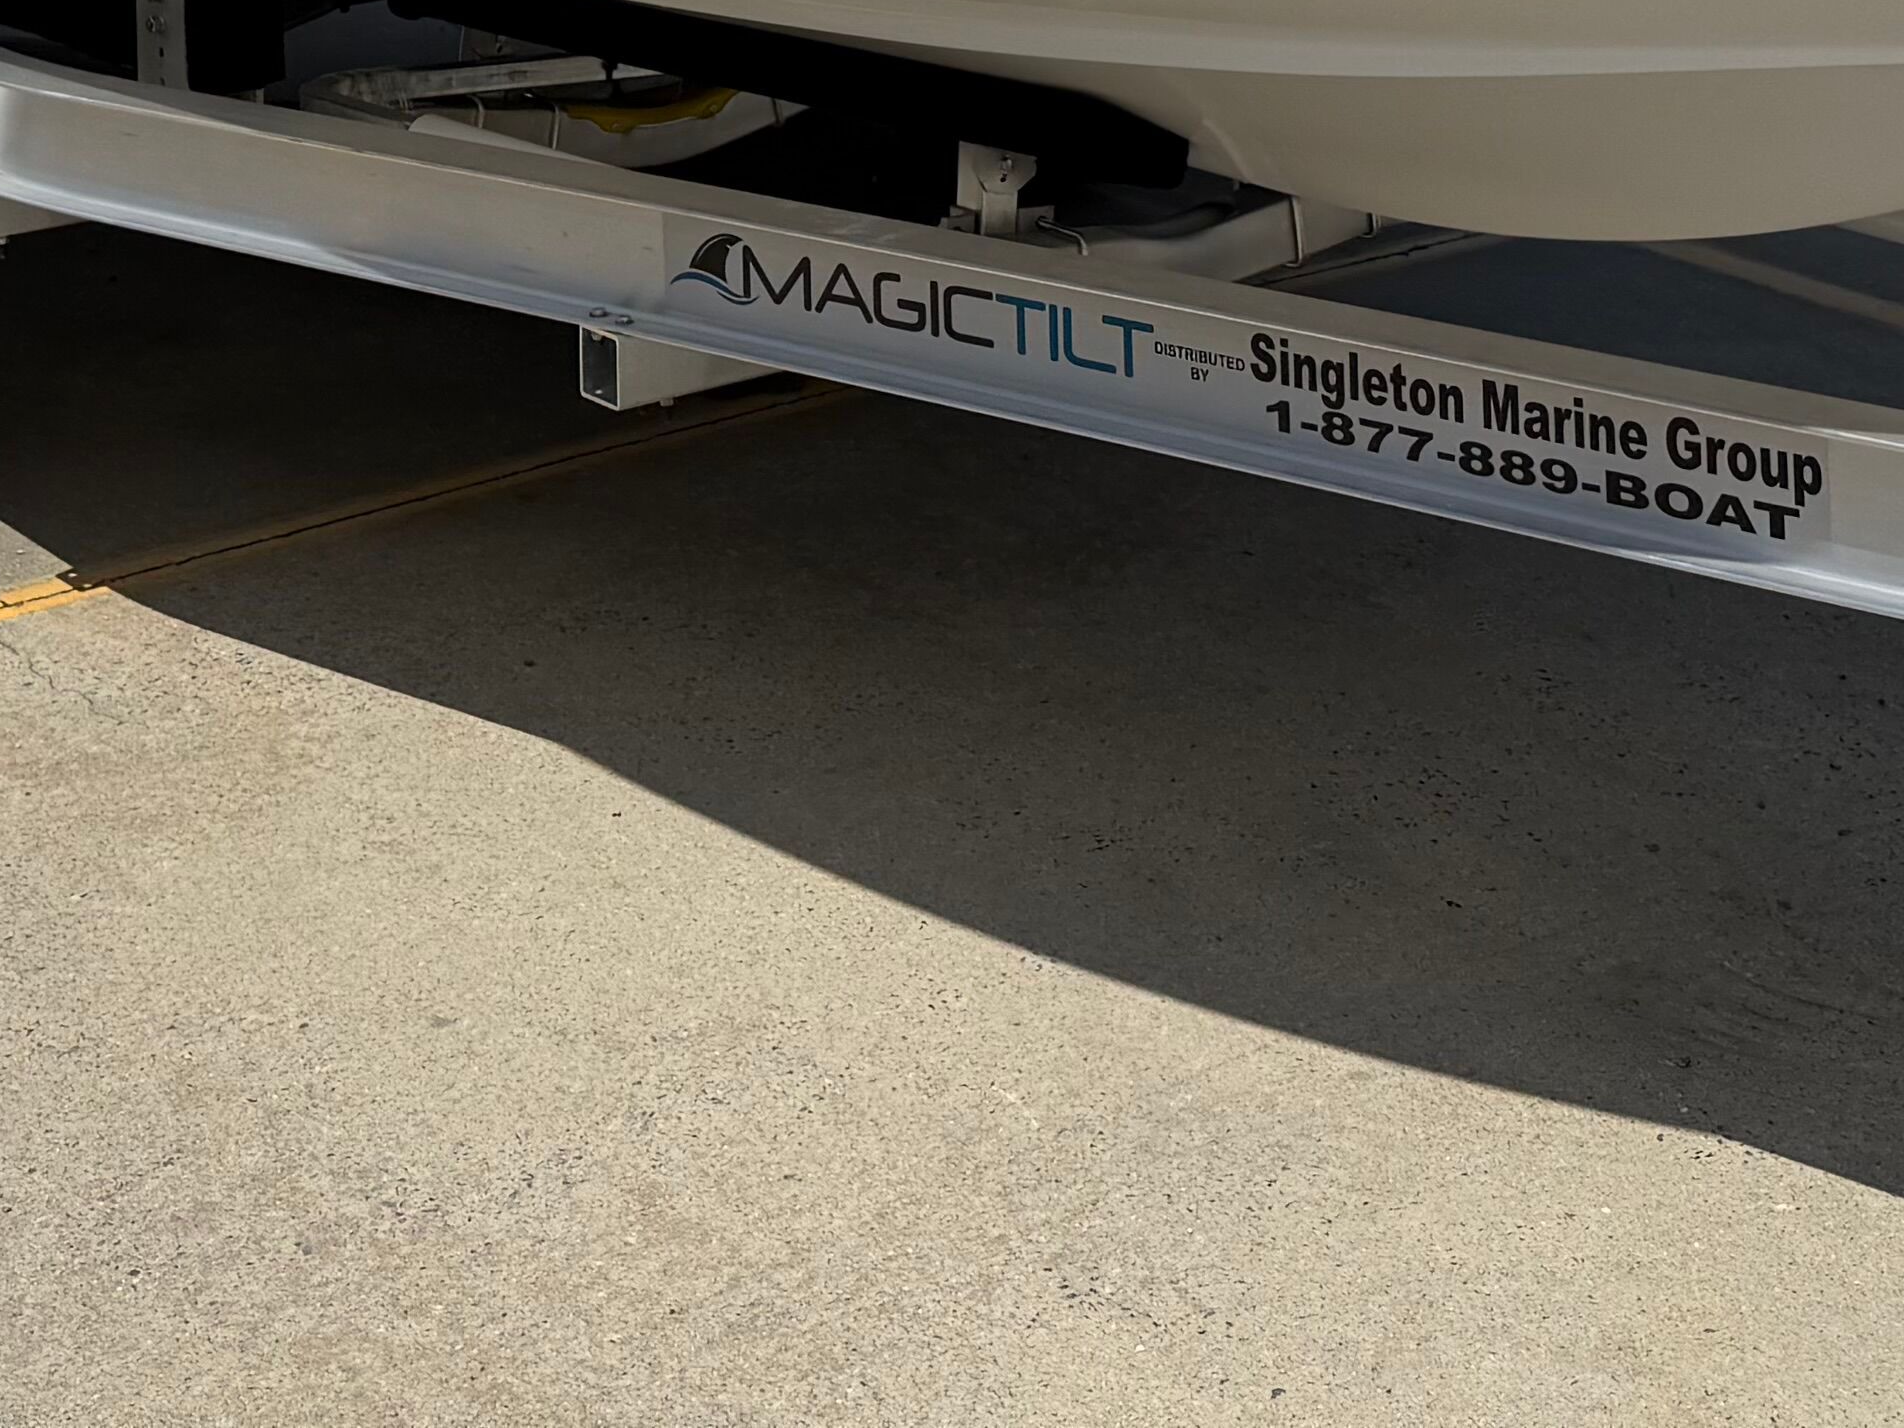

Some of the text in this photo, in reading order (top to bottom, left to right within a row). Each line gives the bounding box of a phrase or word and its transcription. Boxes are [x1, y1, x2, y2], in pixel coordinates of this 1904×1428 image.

[1154, 341, 1246, 372] DISTRIBUTED
[1190, 366, 1209, 382] BY
[1250, 332, 1824, 506] Singleton Marine Group
[1265, 401, 1801, 541] 1-877-889-BOAT
